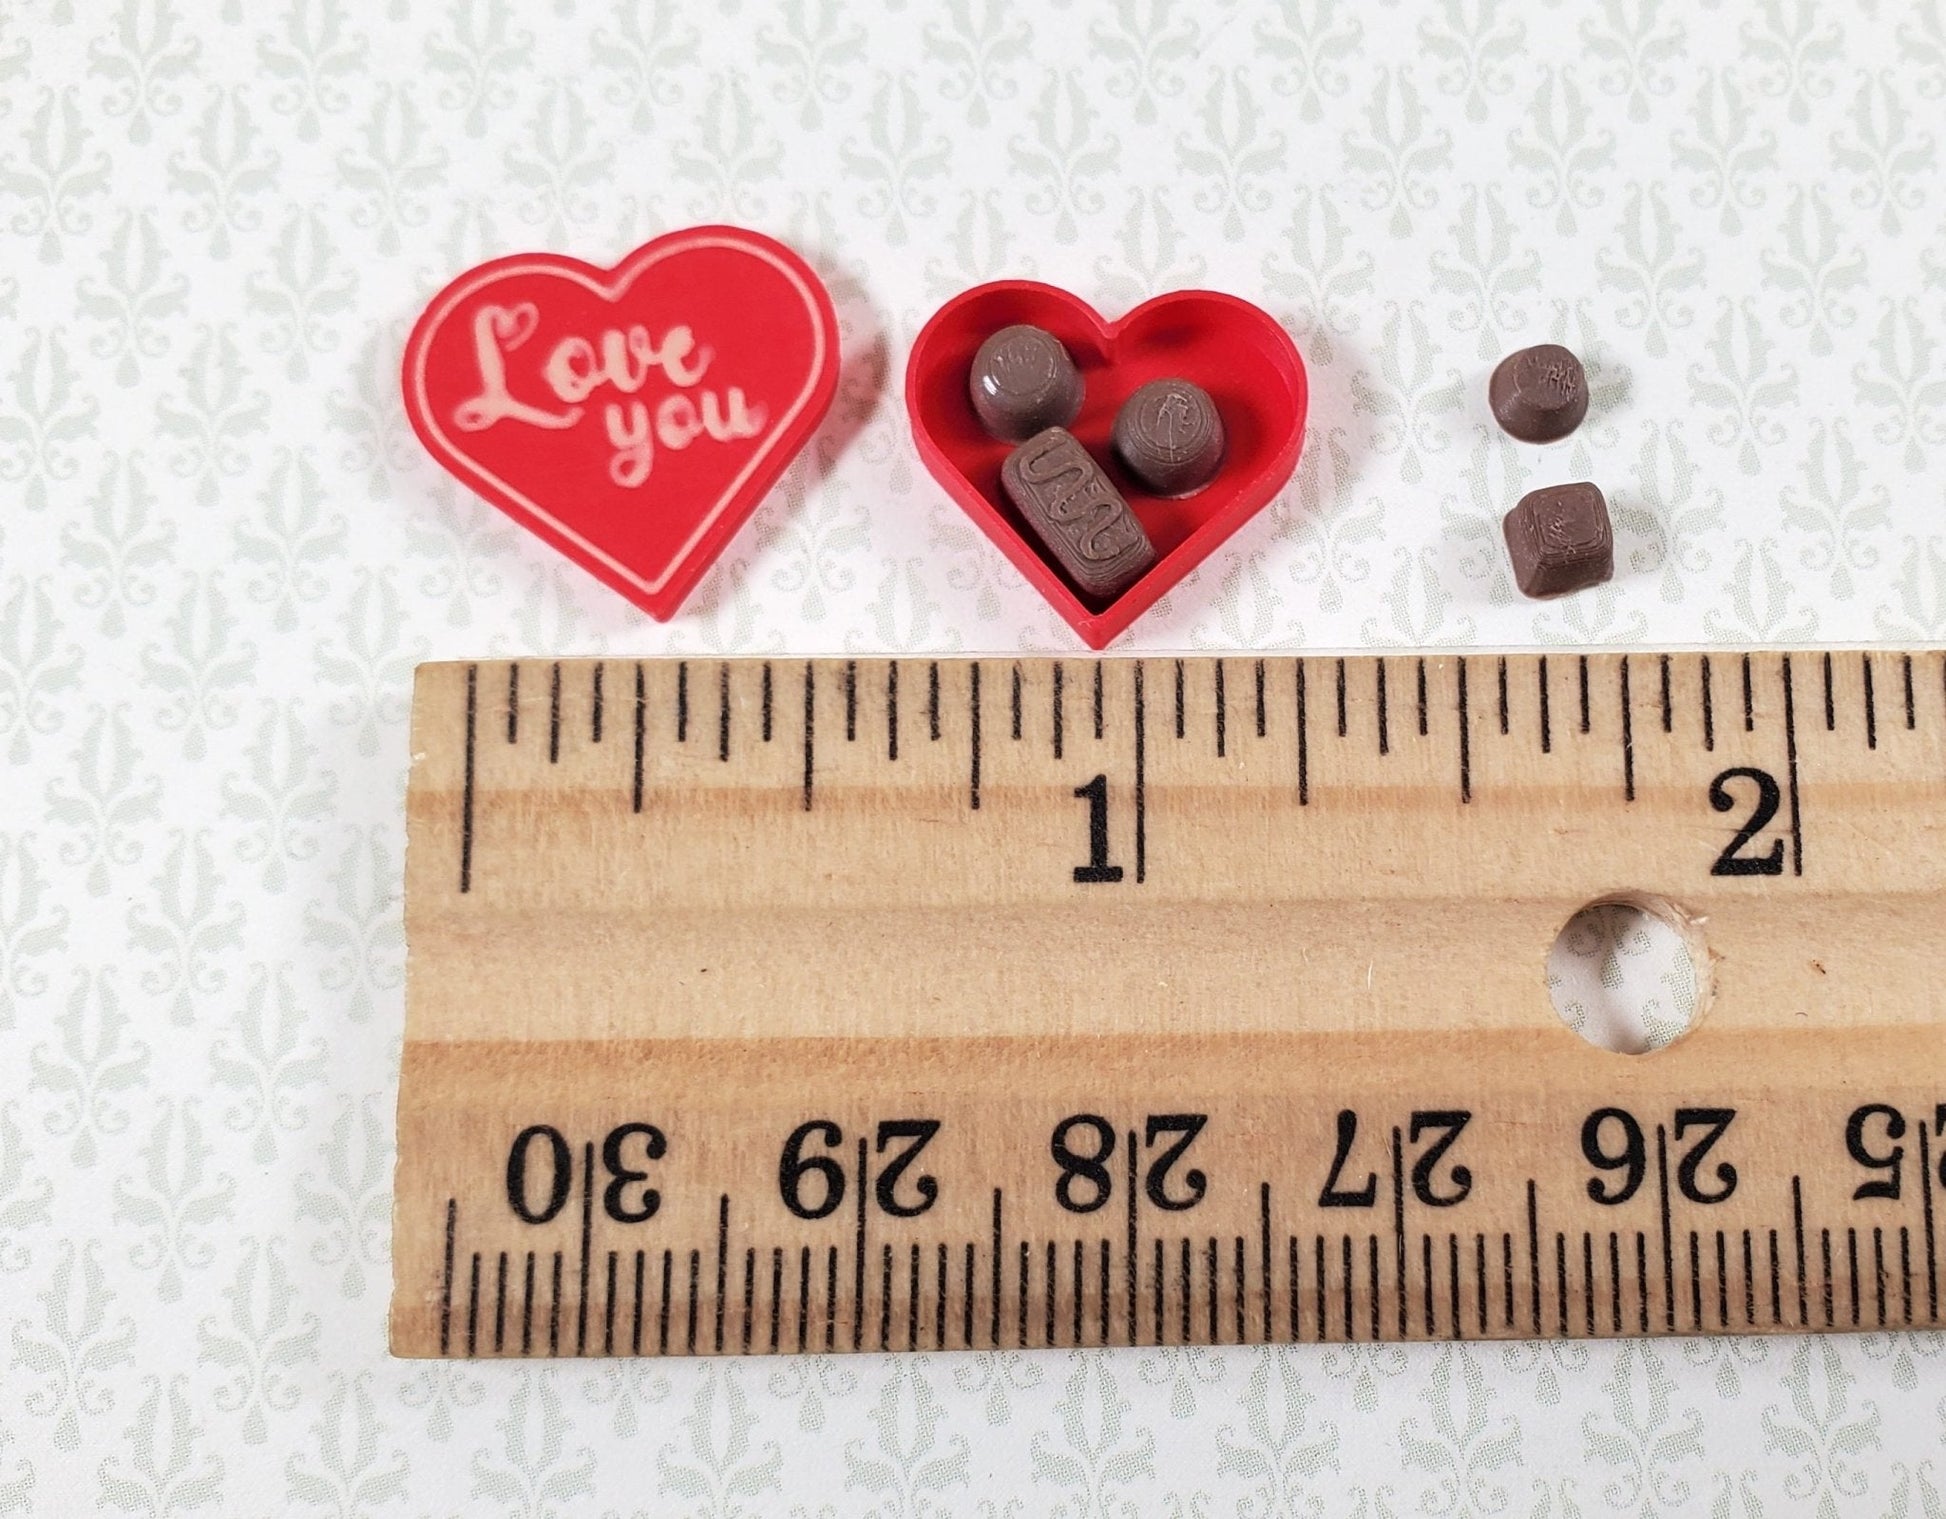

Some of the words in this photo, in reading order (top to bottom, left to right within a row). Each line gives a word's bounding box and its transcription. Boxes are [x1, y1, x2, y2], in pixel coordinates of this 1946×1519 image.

[454, 300, 712, 432] Love
[603, 382, 766, 488] you
[1072, 772, 1123, 883] 1
[1708, 766, 1784, 877] 2
[505, 1122, 668, 1225] 30
[779, 1119, 941, 1220] 29
[1050, 1113, 1208, 1214] 28
[1318, 1109, 1473, 1208] 27
[1580, 1107, 1738, 1205] 26
[1845, 1103, 1946, 1201] 5
